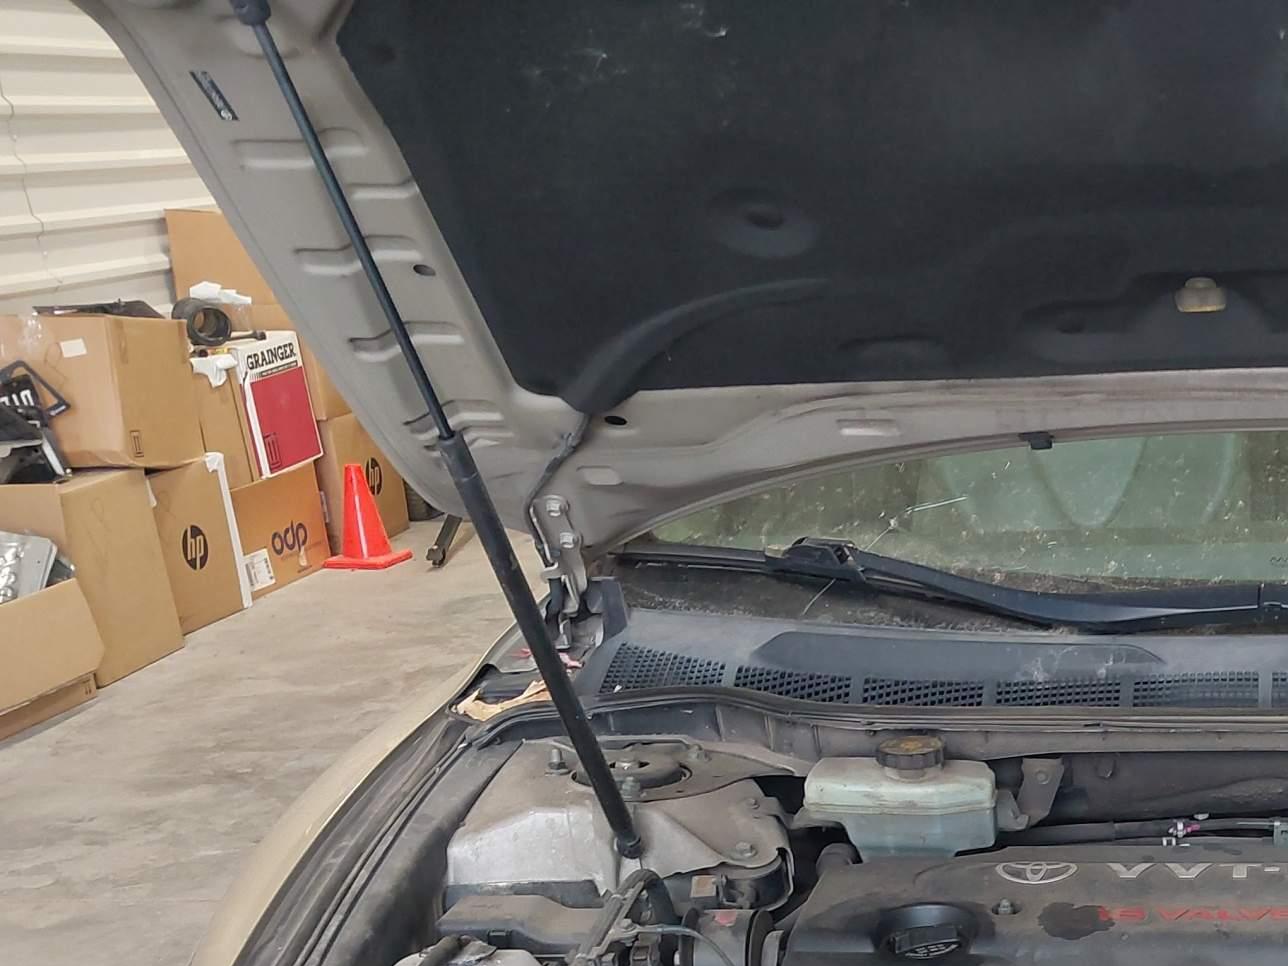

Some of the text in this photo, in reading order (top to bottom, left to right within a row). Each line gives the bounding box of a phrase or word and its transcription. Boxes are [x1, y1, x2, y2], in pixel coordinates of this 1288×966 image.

[246, 342, 297, 370] GRAINGER
[366, 458, 382, 496] hp
[184, 524, 207, 570] hp
[271, 519, 308, 556] odp
